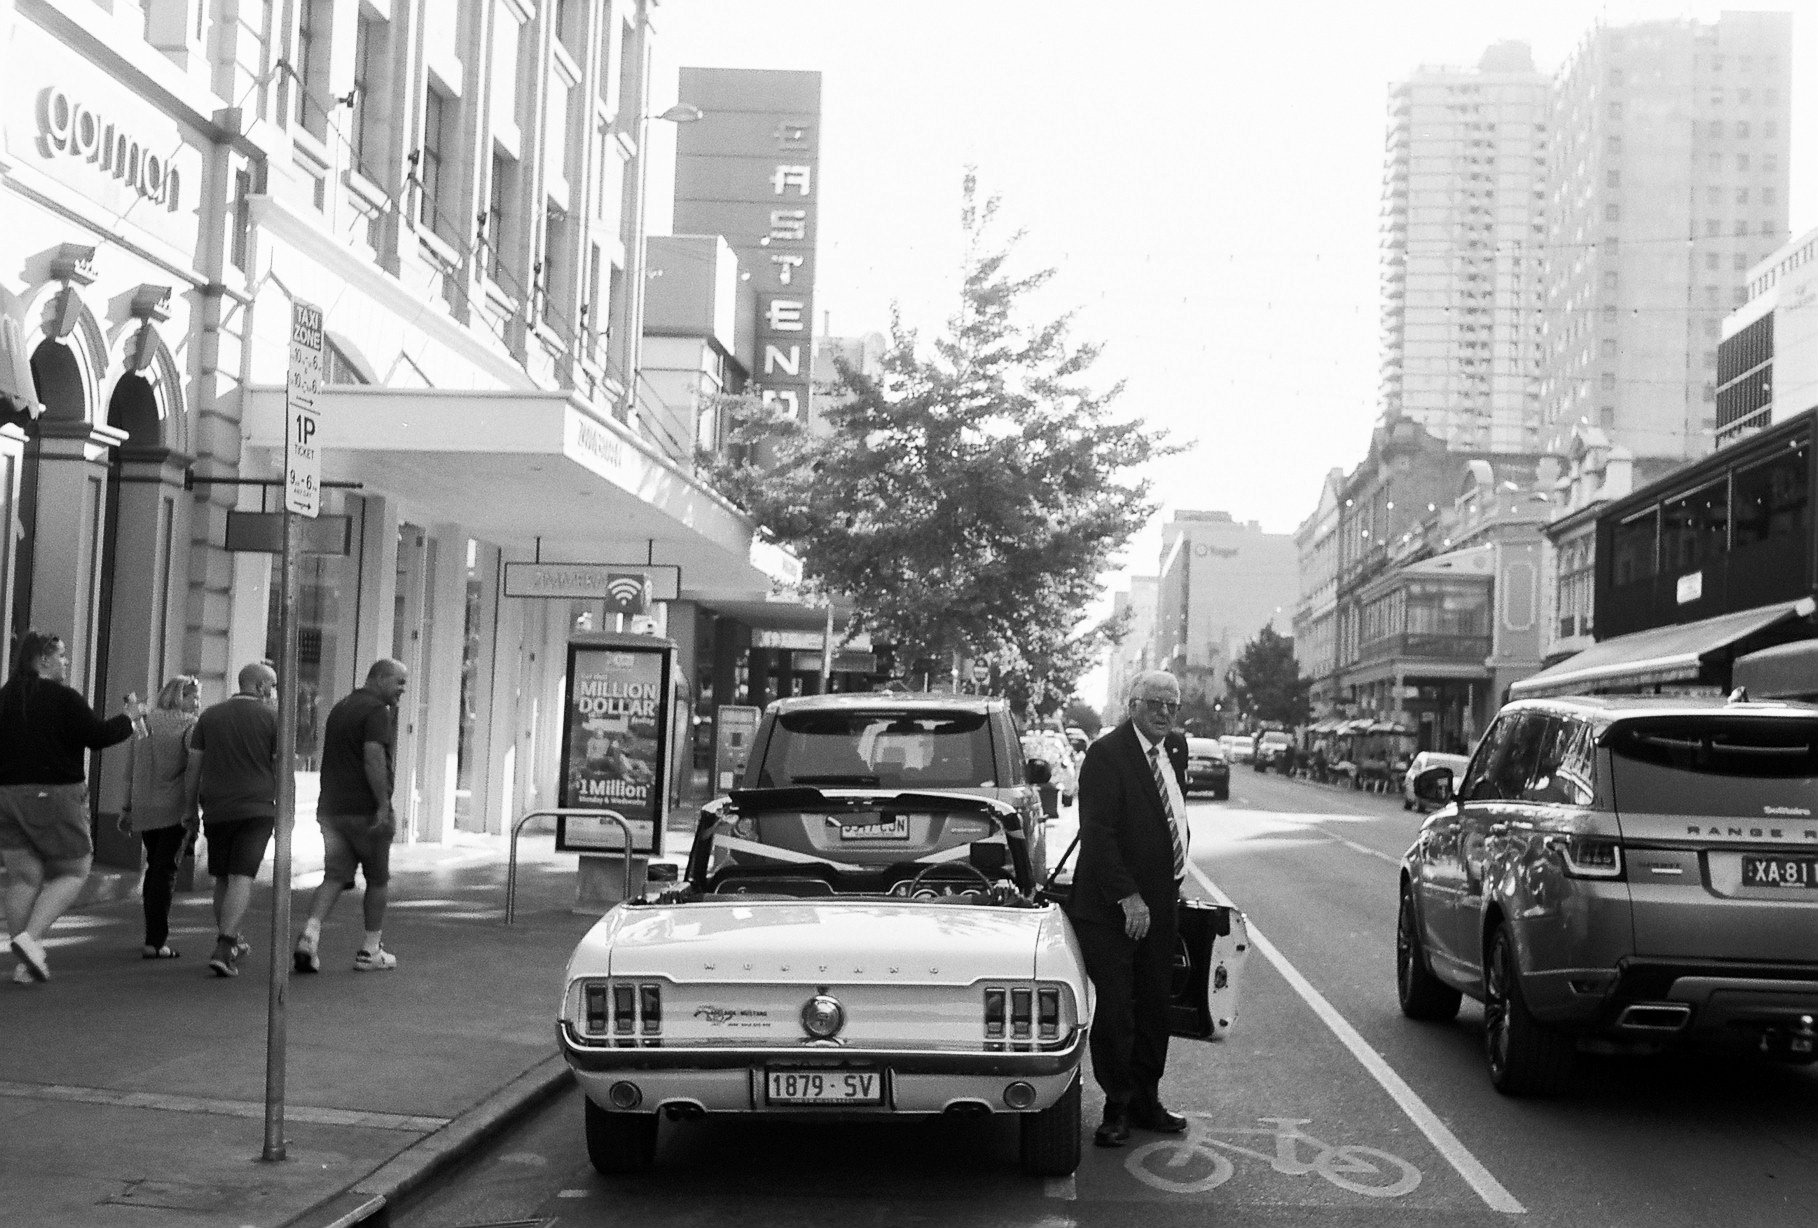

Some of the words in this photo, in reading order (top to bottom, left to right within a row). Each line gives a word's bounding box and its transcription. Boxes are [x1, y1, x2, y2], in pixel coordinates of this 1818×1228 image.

[35, 82, 180, 213] gorman
[296, 305, 320, 330] TAXI
[293, 323, 321, 349] ZONE
[296, 414, 316, 445] 1P
[294, 443, 315, 460] TICKET
[580, 680, 656, 701] MILLION
[579, 696, 656, 718] DOLLAR
[1687, 825, 1784, 838] RANGE
[704, 963, 939, 975] MUSTANG
